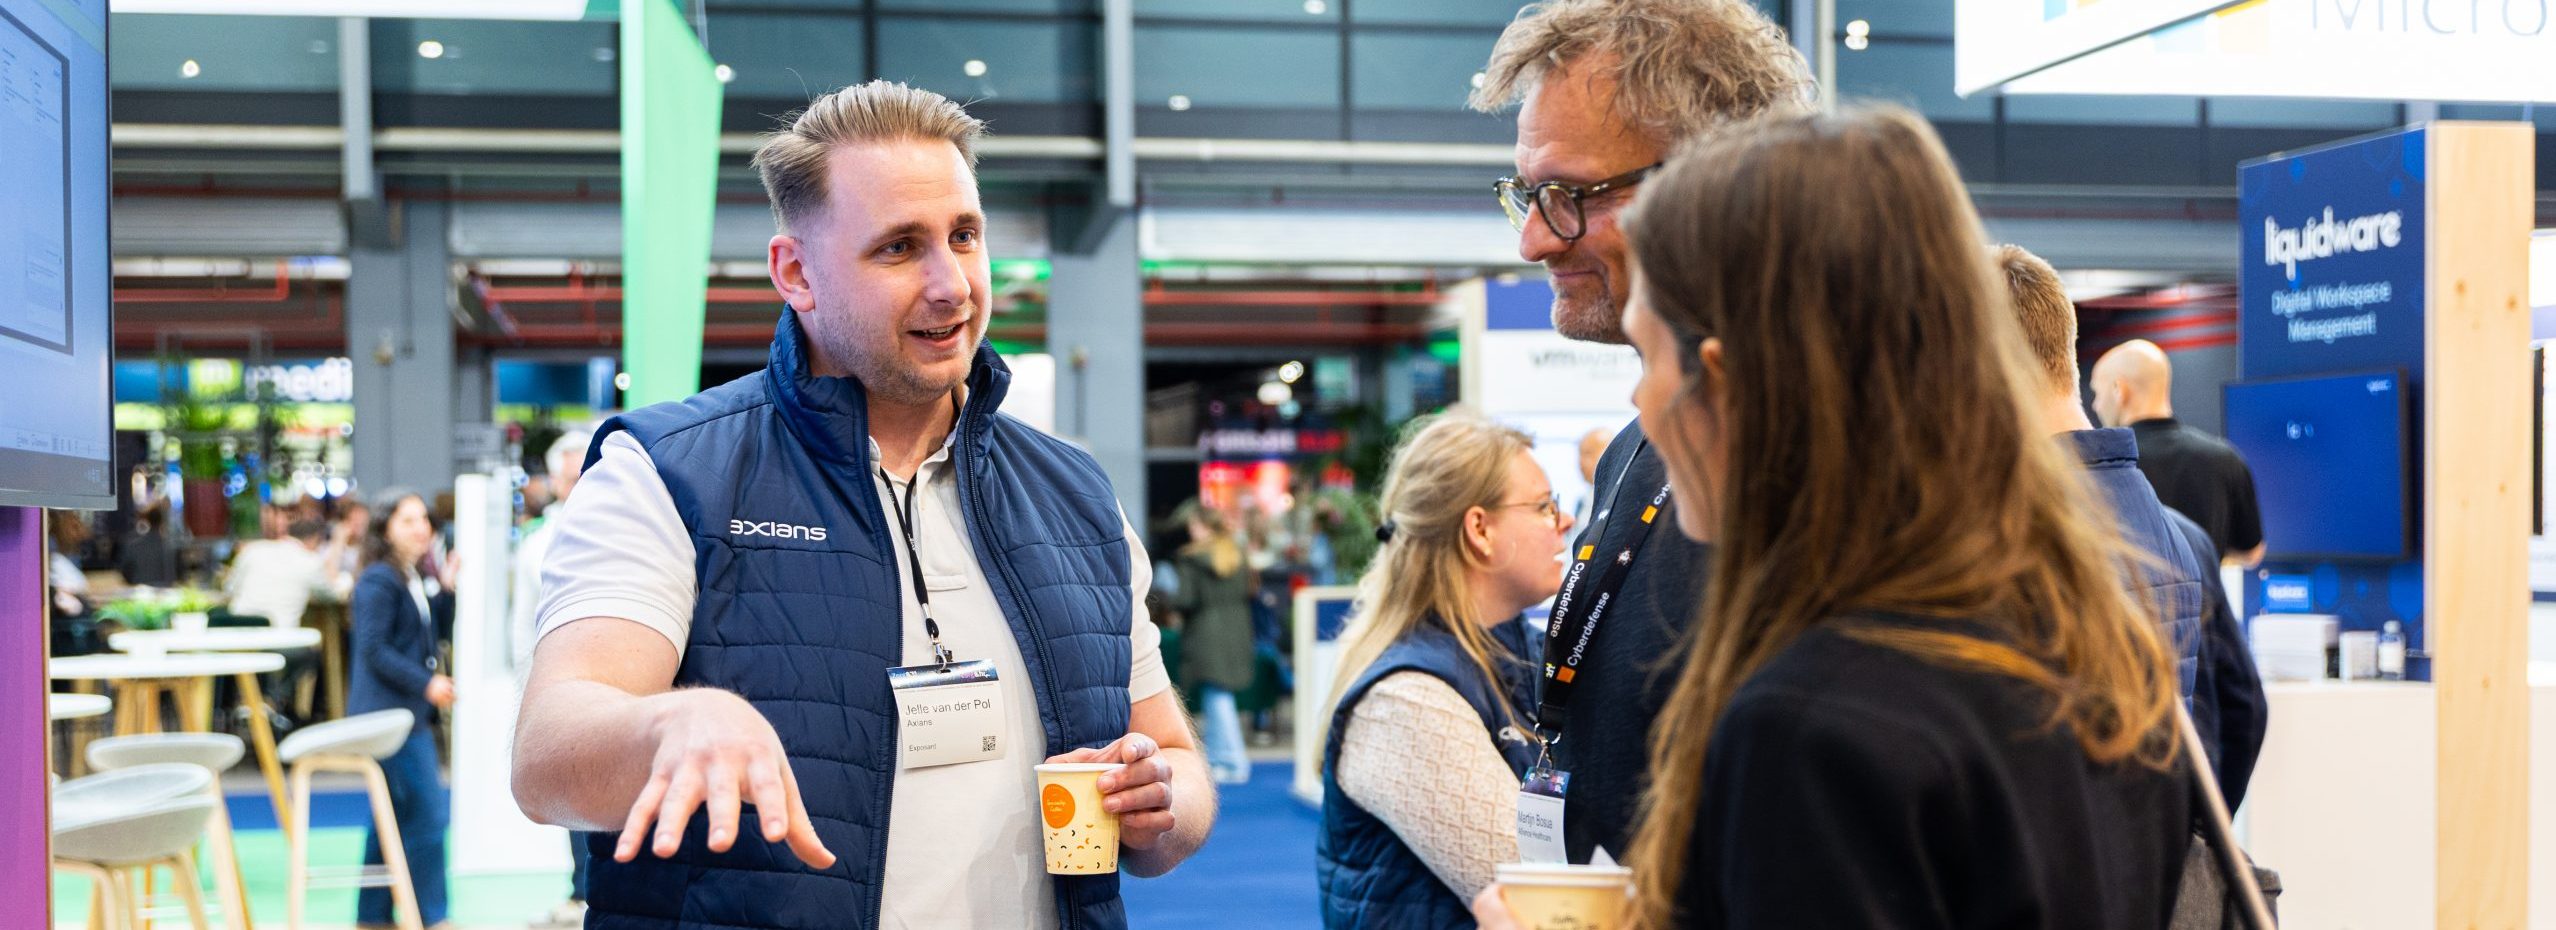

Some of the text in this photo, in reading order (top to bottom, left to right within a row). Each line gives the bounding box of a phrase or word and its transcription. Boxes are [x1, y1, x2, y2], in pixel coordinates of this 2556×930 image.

[2265, 205, 2402, 281] liquidware
[2271, 280, 2392, 318] Digital Workspace
[2288, 311, 2376, 344] Management
[1549, 562, 1586, 639] Cyberdefense
[1566, 591, 1610, 667] Cyberdefense
[905, 698, 991, 716] Jelle van der Pol
[907, 719, 933, 727] Axians
